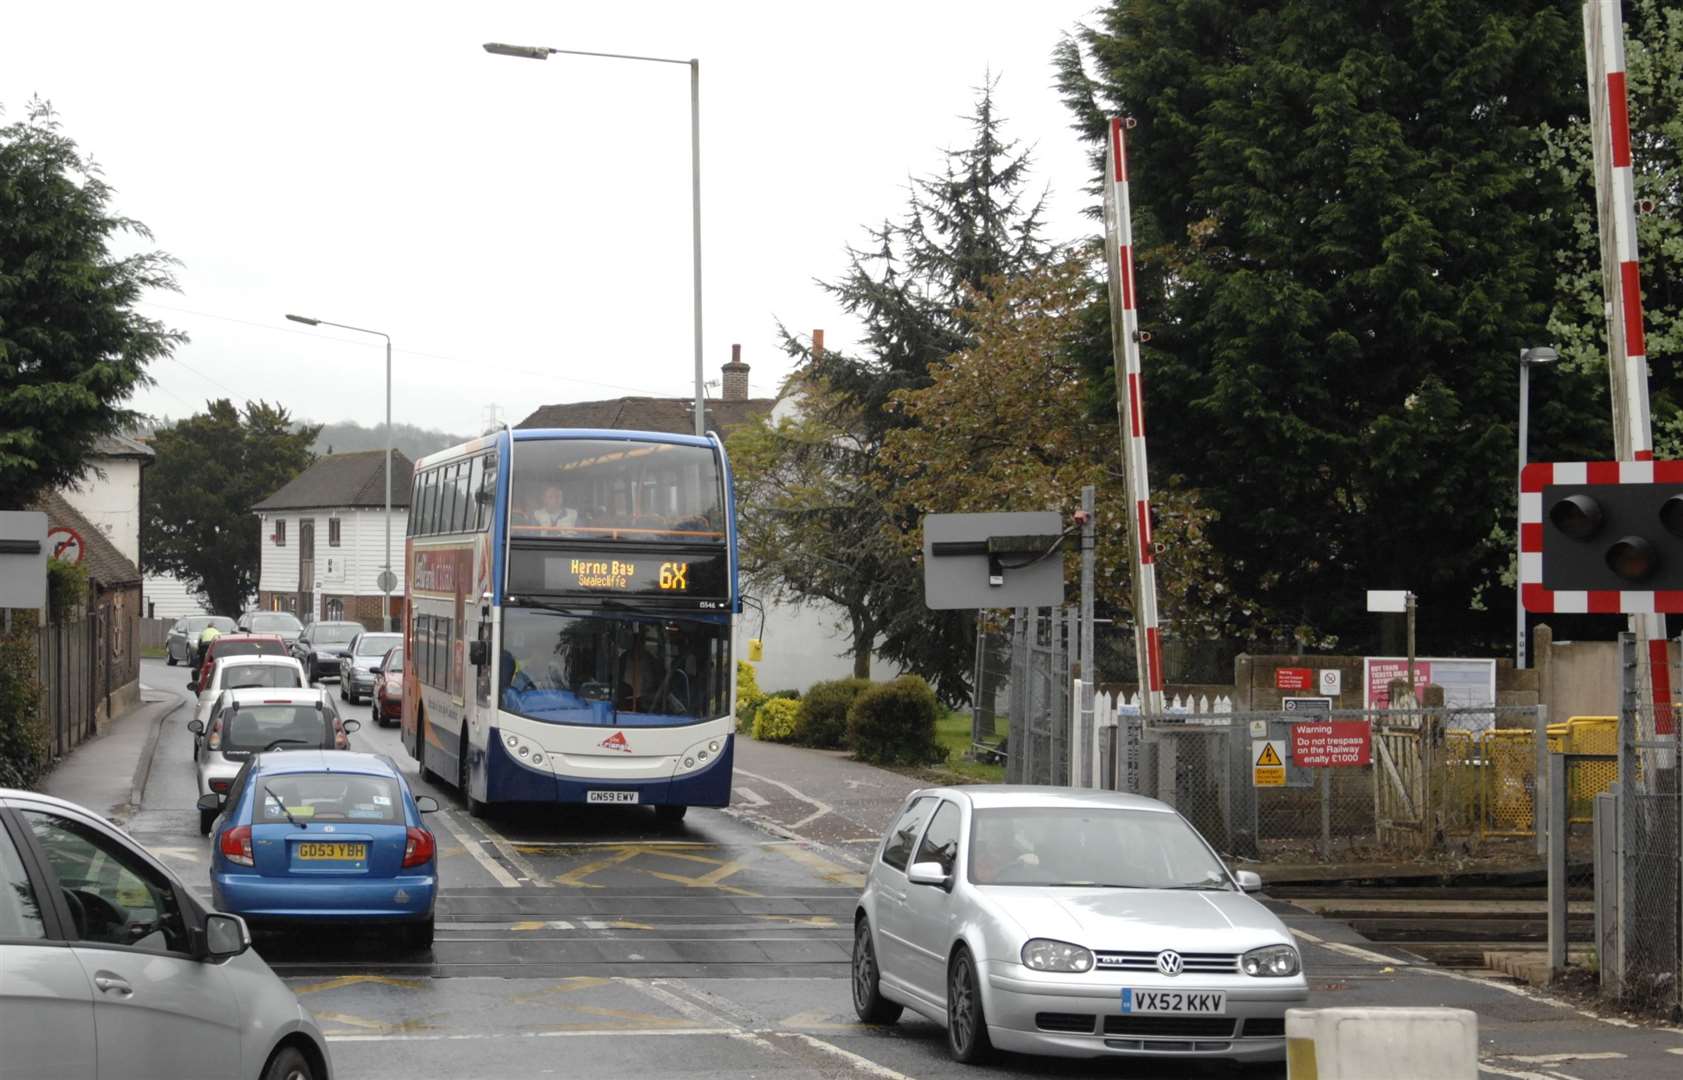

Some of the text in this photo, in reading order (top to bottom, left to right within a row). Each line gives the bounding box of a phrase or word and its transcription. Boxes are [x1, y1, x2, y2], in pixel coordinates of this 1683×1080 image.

[571, 559, 635, 577] Herne Bay
[659, 562, 688, 590] 6X
[1297, 725, 1333, 735] Warning
[1297, 737, 1364, 746] Do not trespass
[1310, 746, 1324, 754] the
[1326, 745, 1360, 755] Railway
[1304, 754, 1359, 764] enalty £1000
[590, 793, 634, 801] GN59 EWV
[300, 843, 364, 857] GD53 YBH
[1135, 993, 1222, 1012] VX52 KKV
